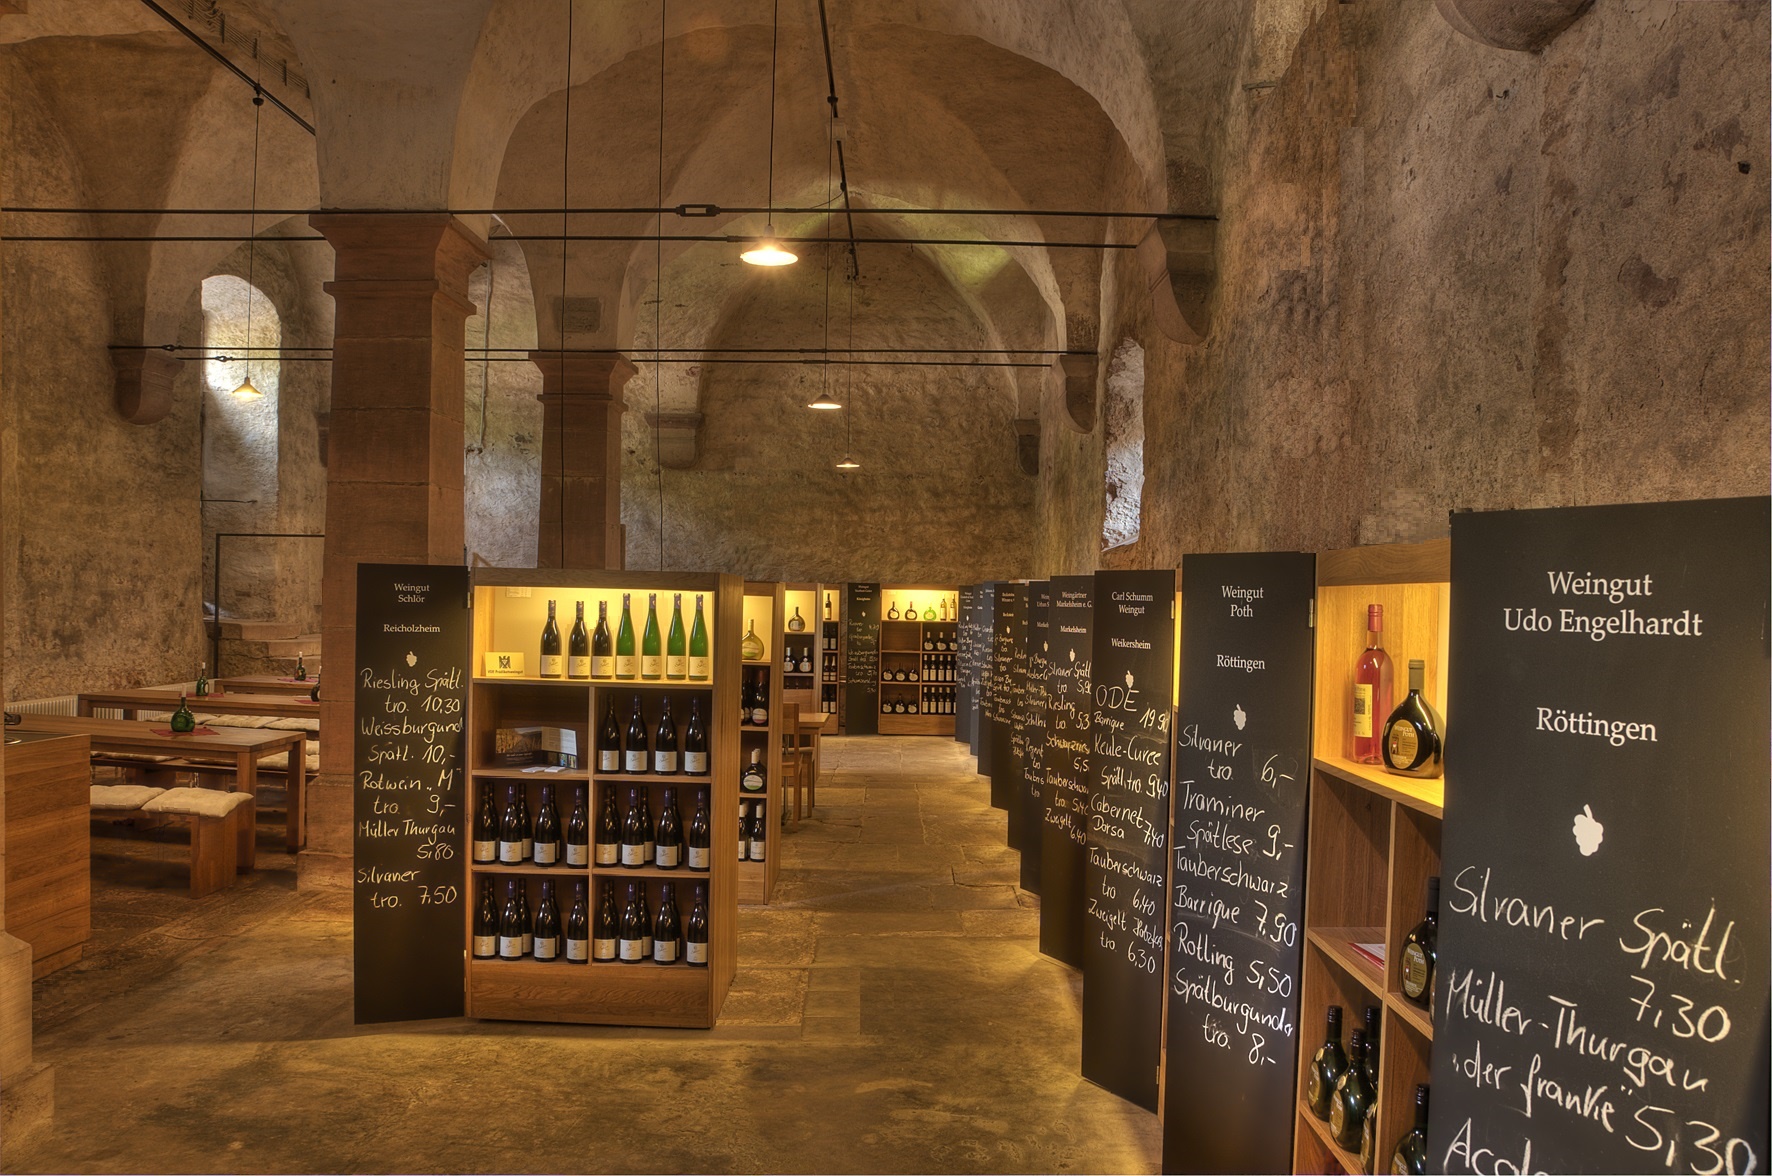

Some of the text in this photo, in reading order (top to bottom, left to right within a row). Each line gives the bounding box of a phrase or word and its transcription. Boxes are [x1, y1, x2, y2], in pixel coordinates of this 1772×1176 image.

[394, 583, 430, 594] Weingut
[398, 594, 425, 603] Schlör
[1062, 591, 1087, 600] Weingärtner
[1111, 591, 1153, 601] Carl Schumm
[1222, 586, 1264, 602] Weingut
[1548, 571, 1653, 604] Weingut
[1056, 600, 1082, 608] Markelsheim
[1119, 604, 1145, 616] Weingut
[1230, 605, 1253, 617] Poth
[384, 624, 441, 633] Reicholzheim
[1060, 625, 1087, 633] Markelsheim
[1504, 608, 1703, 642] Udo Engelhardt
[1111, 638, 1151, 649] Weikersheim
[1217, 654, 1265, 673] Röttingen
[360, 668, 421, 695] Riesling
[421, 695, 460, 714] 10,30
[1048, 693, 1076, 719] Riesling
[1096, 685, 1139, 712] ODE
[1536, 707, 1658, 746] Röttingen
[1179, 724, 1242, 757] Silvaner
[359, 770, 421, 790] Rotwein
[1180, 780, 1265, 822] Traminer
[1044, 807, 1072, 830] Zweigelt
[1092, 815, 1125, 839] Dorsa
[359, 819, 456, 846] Müller Thurgau
[1187, 820, 1253, 855] Spätlese
[417, 843, 454, 860] 5,80
[357, 866, 421, 884] Silvaner
[1089, 847, 1163, 887] Tauberschwarz
[1173, 846, 1288, 898] Tauberschwarz
[417, 885, 457, 905] 7,50
[1132, 888, 1156, 916] 6,40
[1450, 866, 1604, 940] Silvaner
[1088, 898, 1127, 931] Zweigelt
[1174, 884, 1297, 947] Barrique 7,90
[1128, 941, 1156, 974] 6,30
[1174, 921, 1292, 998] Rotling 5,50
[1629, 975, 1731, 1042] 7,30
[1625, 1105, 1757, 1176] 5,30
